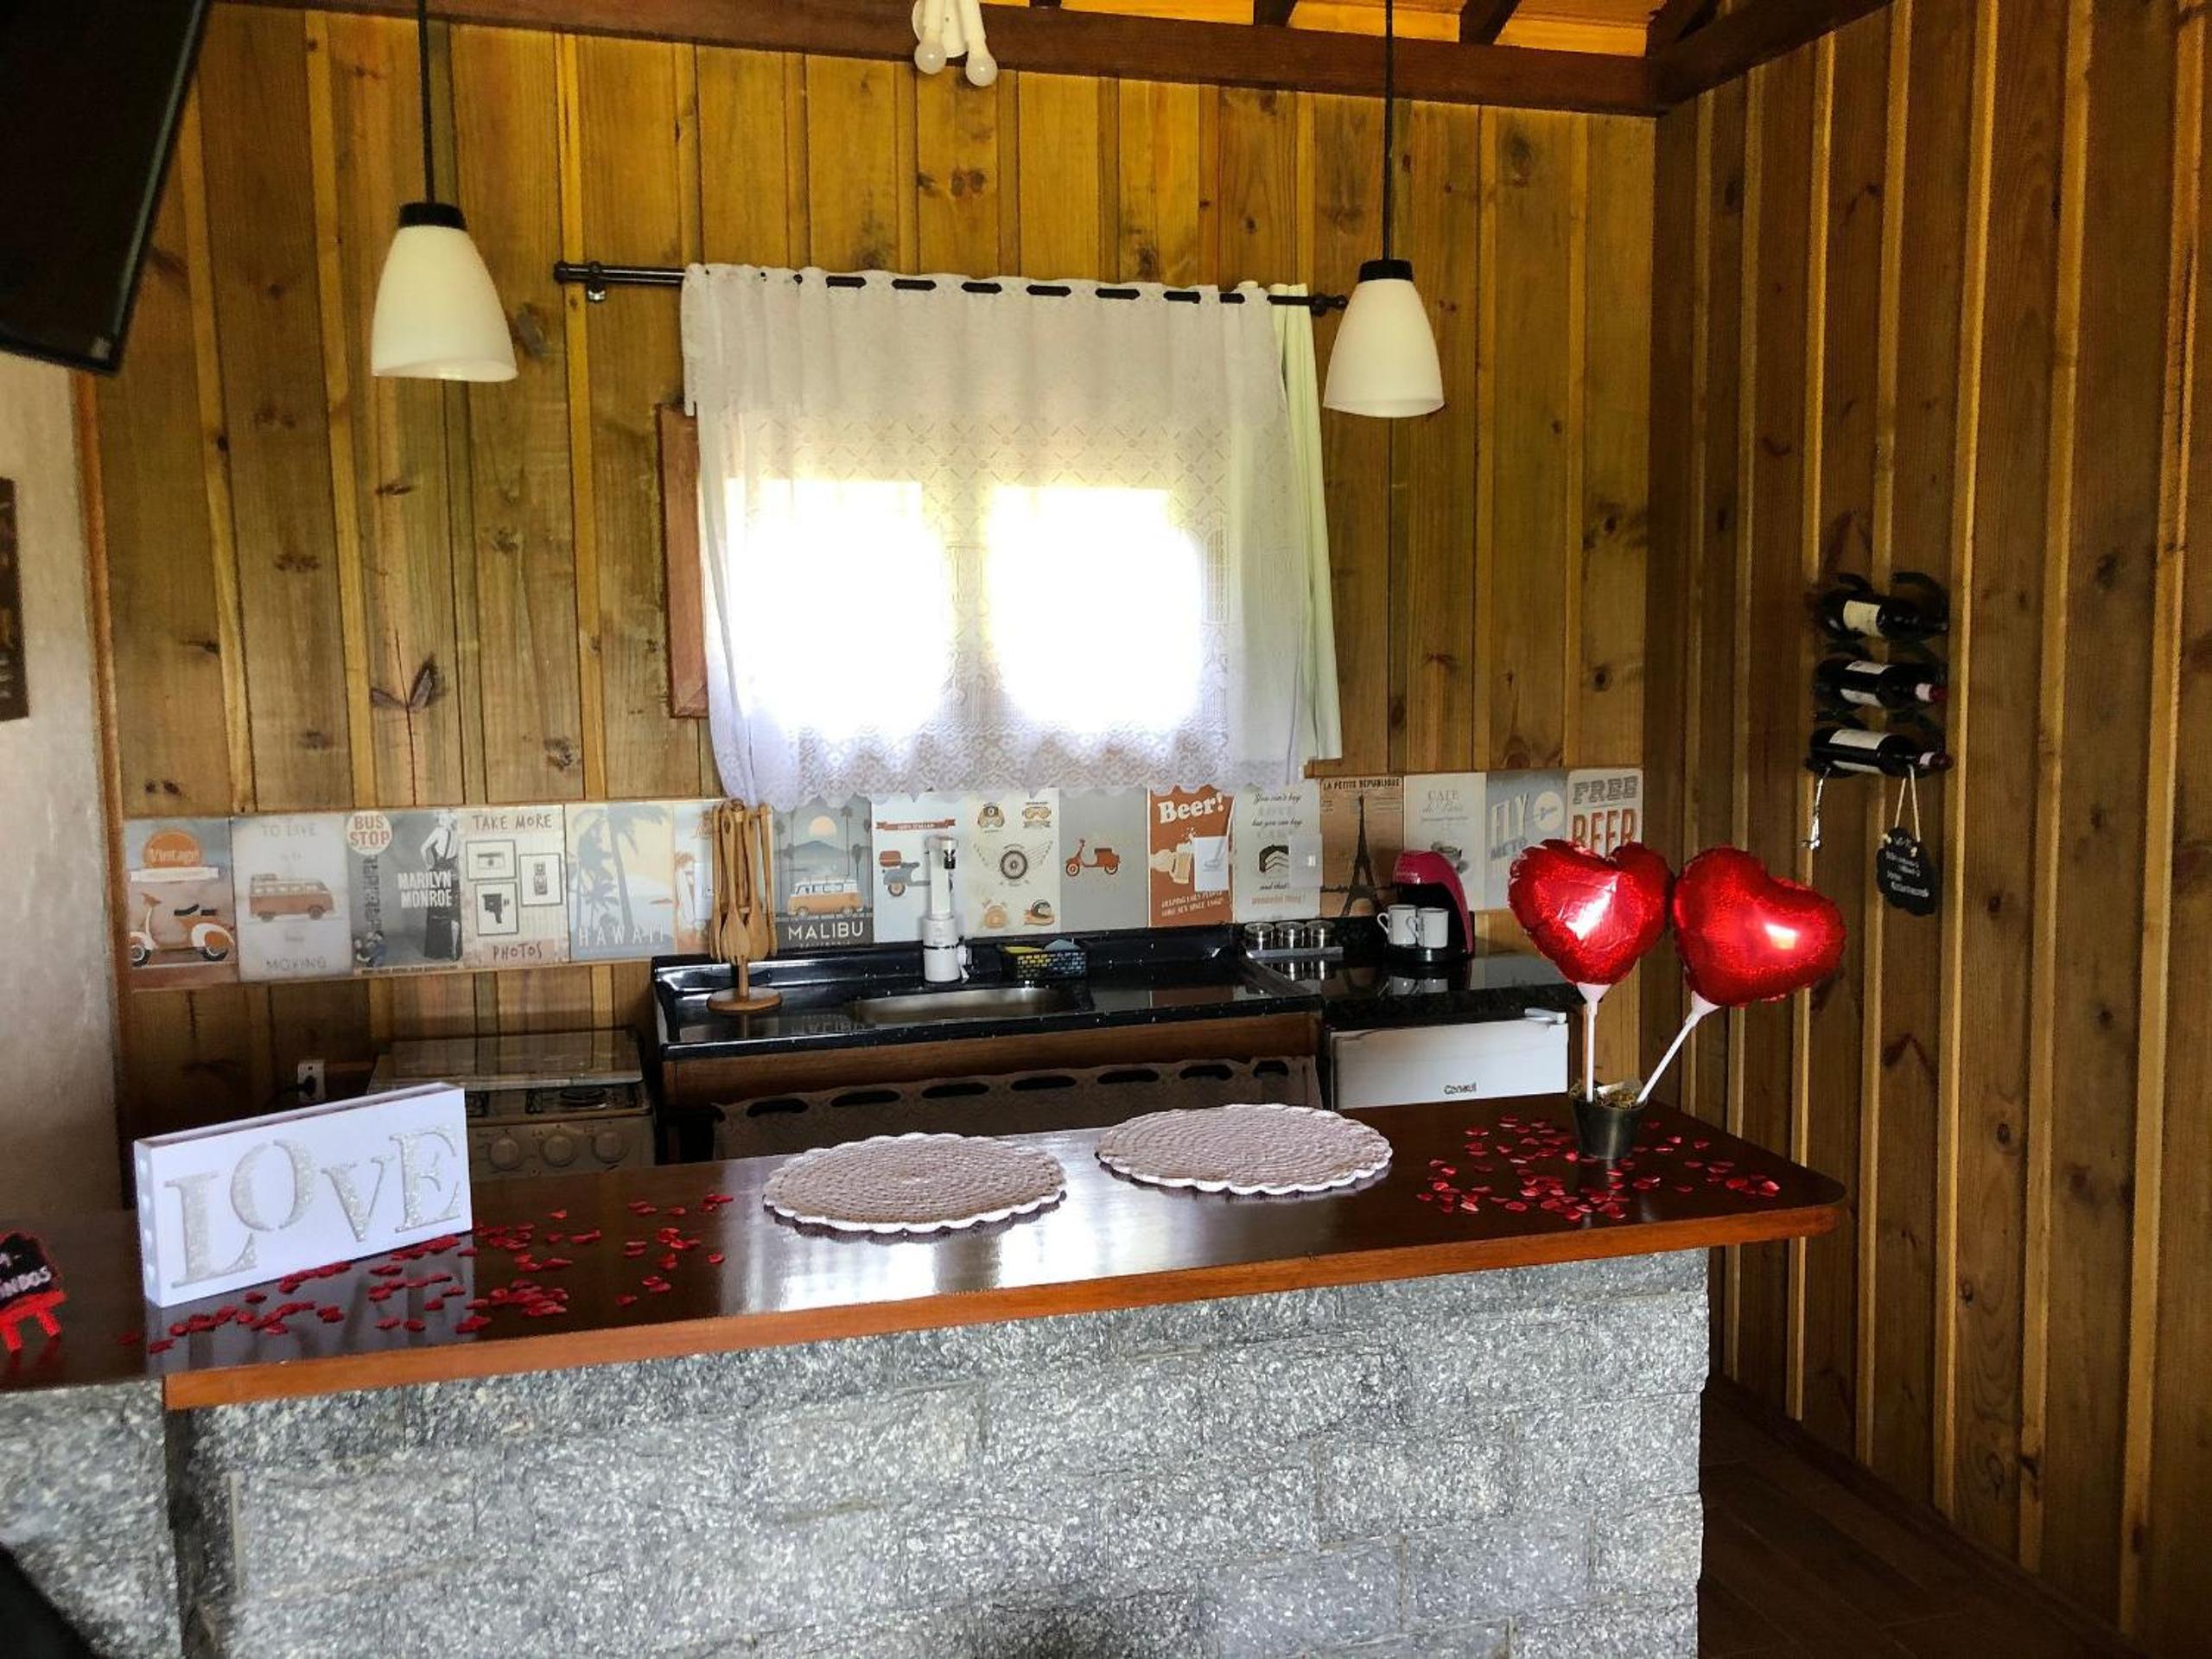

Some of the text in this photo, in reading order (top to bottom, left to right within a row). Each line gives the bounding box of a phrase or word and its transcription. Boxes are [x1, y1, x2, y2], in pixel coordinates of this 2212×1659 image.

[1573, 776, 1638, 804] FREE
[1157, 791, 1224, 823] Beer!
[353, 815, 385, 830] BUS
[471, 813, 553, 830] TAKE MORE
[349, 830, 390, 846] STOP
[397, 870, 452, 890] MARILYN
[400, 888, 453, 909] MONROE
[578, 924, 664, 948] HAWAII
[787, 920, 864, 942] MALIBU
[493, 941, 543, 962] PHOTOS
[164, 1125, 461, 1288] LOVE
